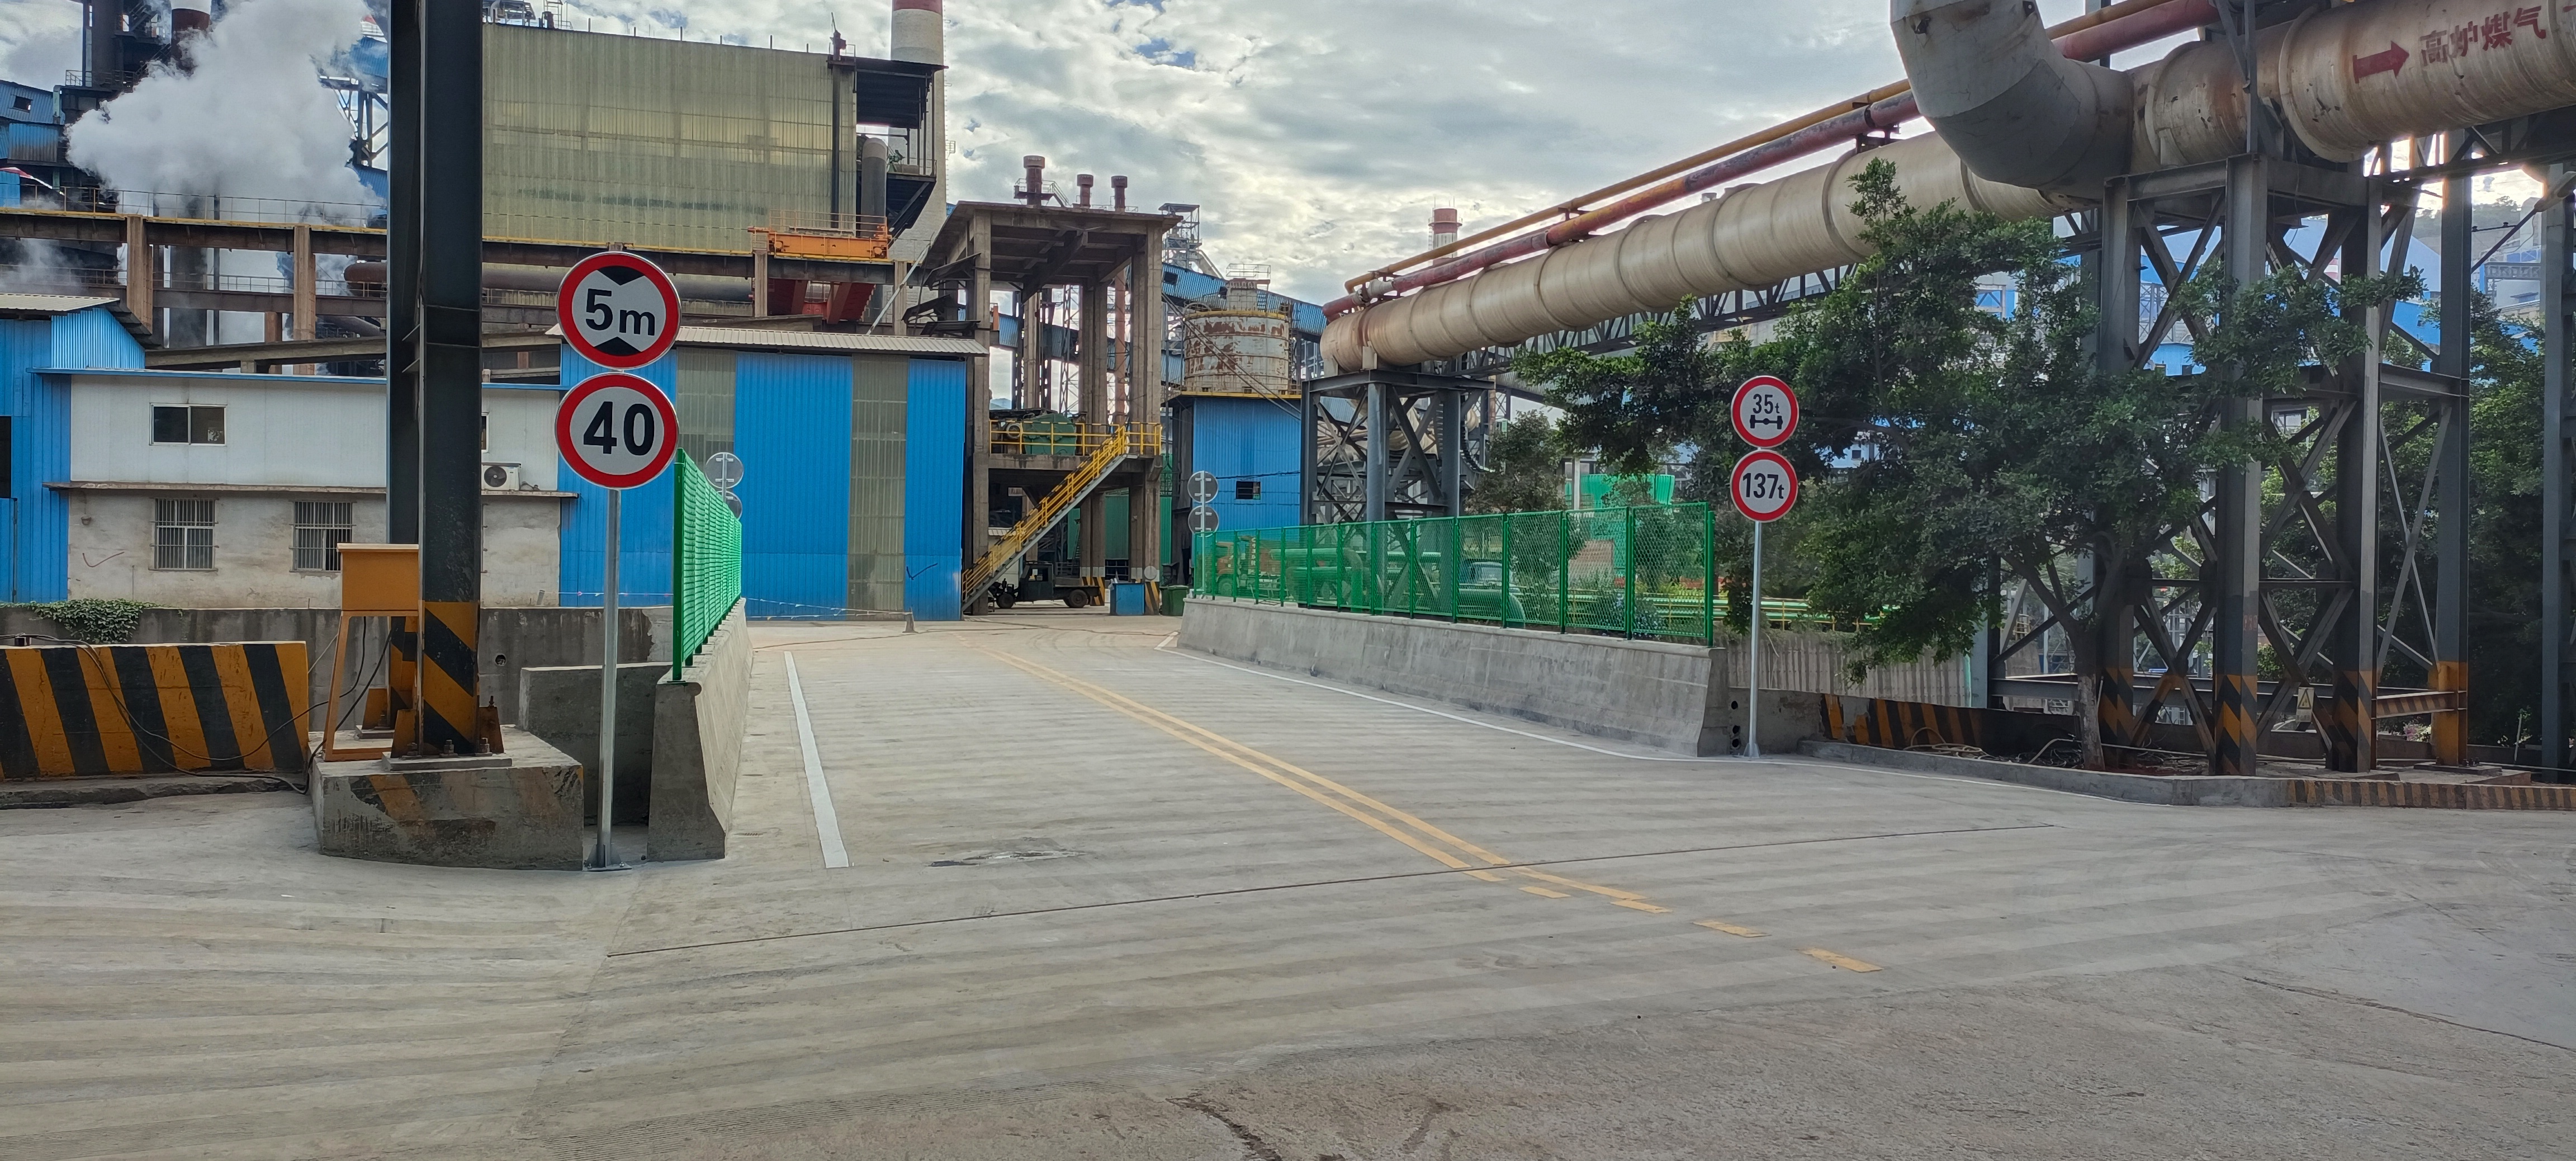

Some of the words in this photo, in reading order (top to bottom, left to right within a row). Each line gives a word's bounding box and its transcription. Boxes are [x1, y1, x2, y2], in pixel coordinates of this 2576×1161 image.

[2419, 6, 2546, 67] 高炉煤气
[585, 288, 655, 336] 5m
[1753, 394, 1780, 414] 35t
[583, 401, 655, 456] 40
[1742, 473, 1784, 499] 137t
